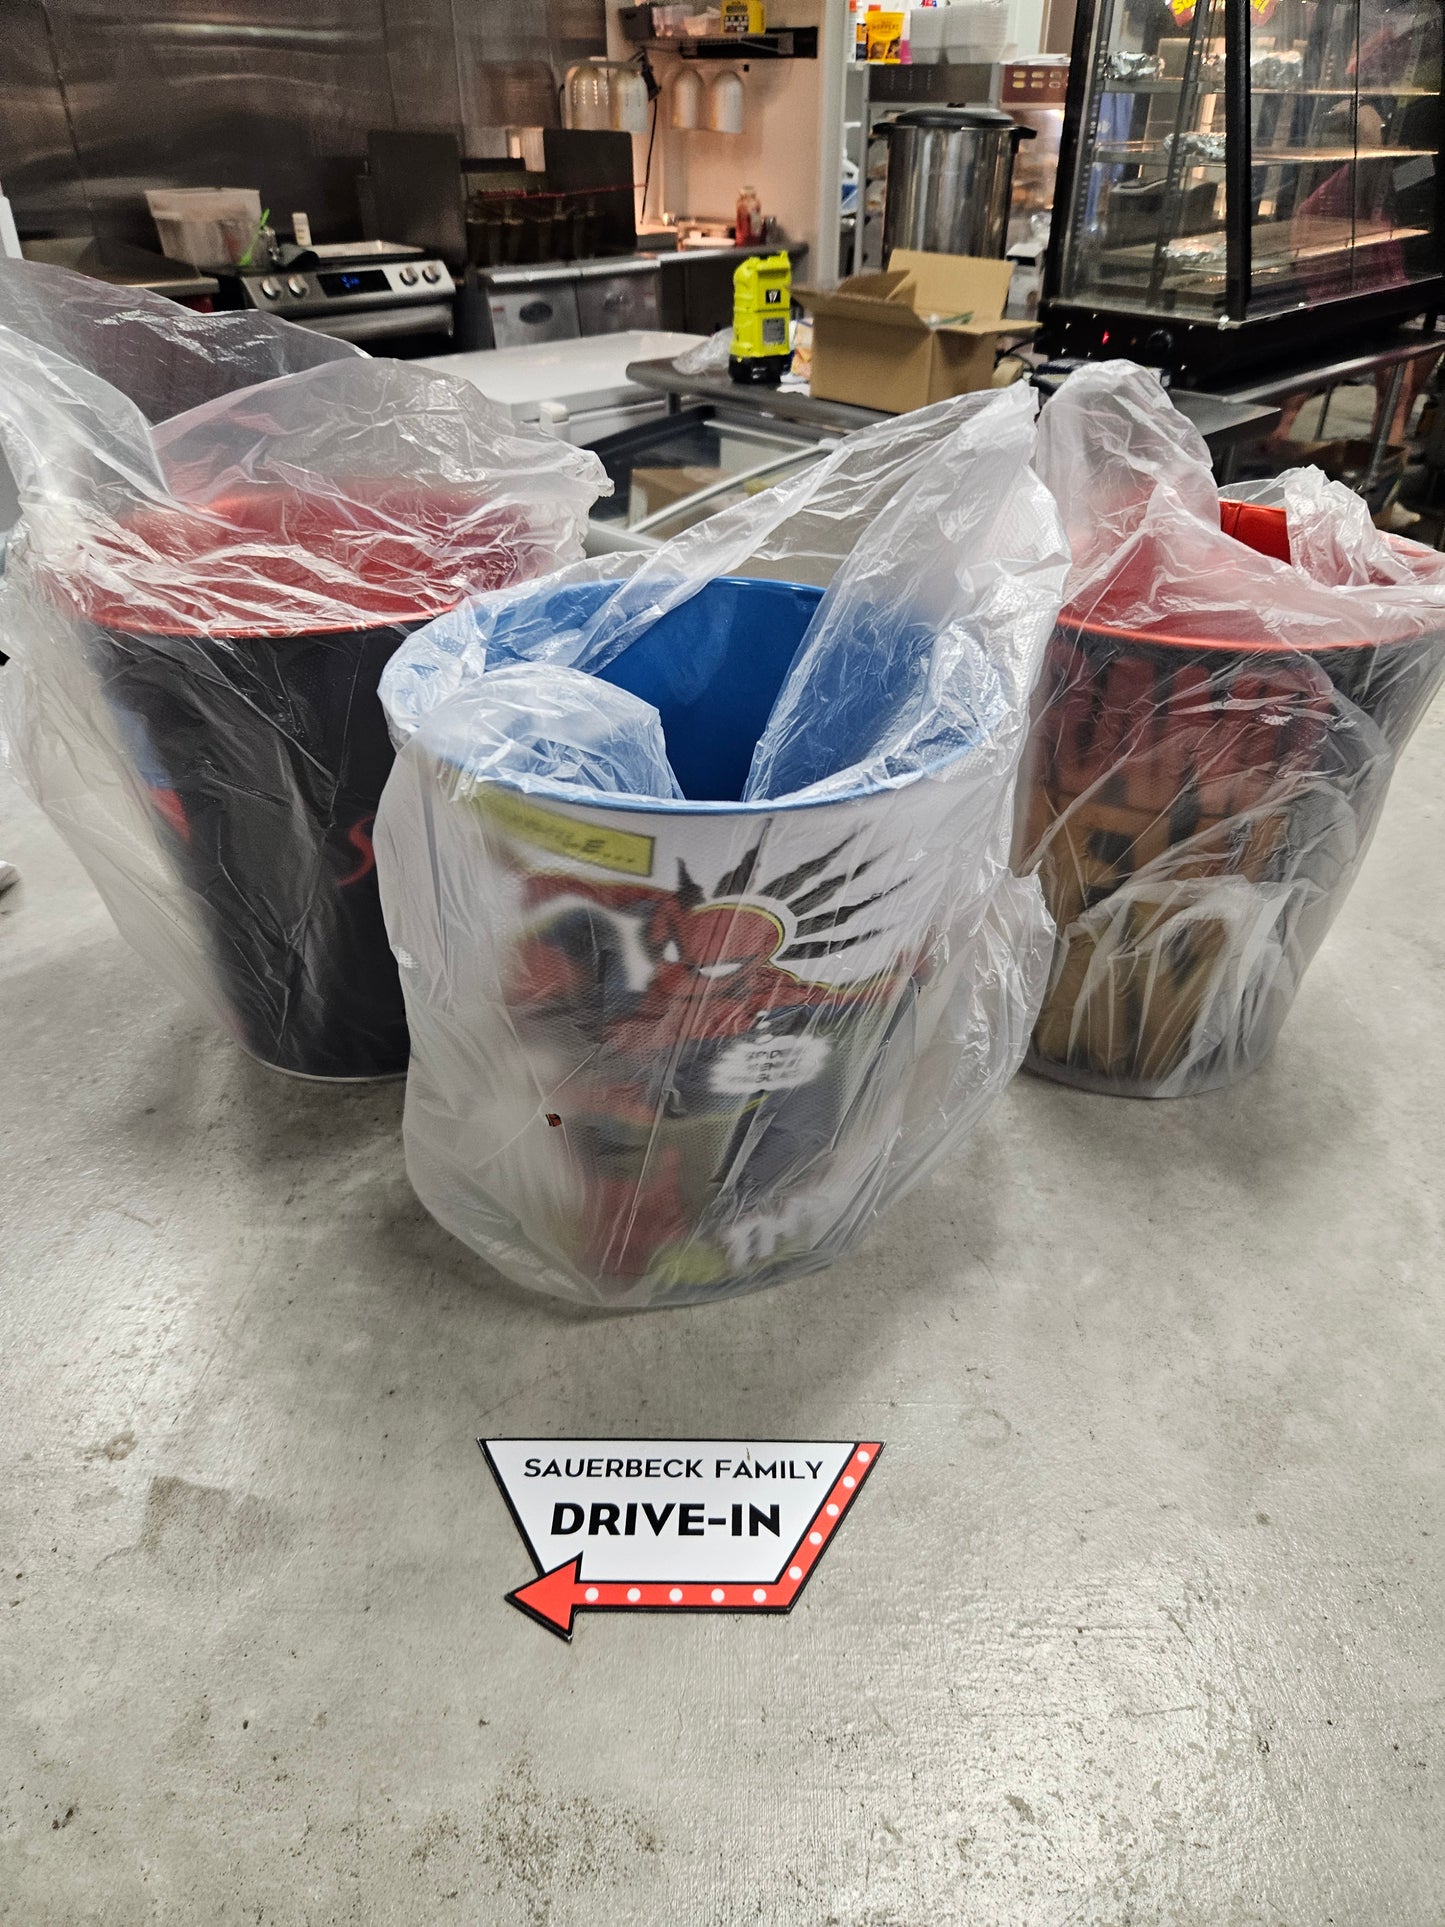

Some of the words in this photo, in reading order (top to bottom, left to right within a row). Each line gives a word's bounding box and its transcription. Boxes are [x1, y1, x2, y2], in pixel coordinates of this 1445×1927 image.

[523, 1458, 704, 1479] SAUERBECK
[714, 1459, 824, 1480] FAMILY
[550, 1502, 781, 1538] DRIVE-IN
